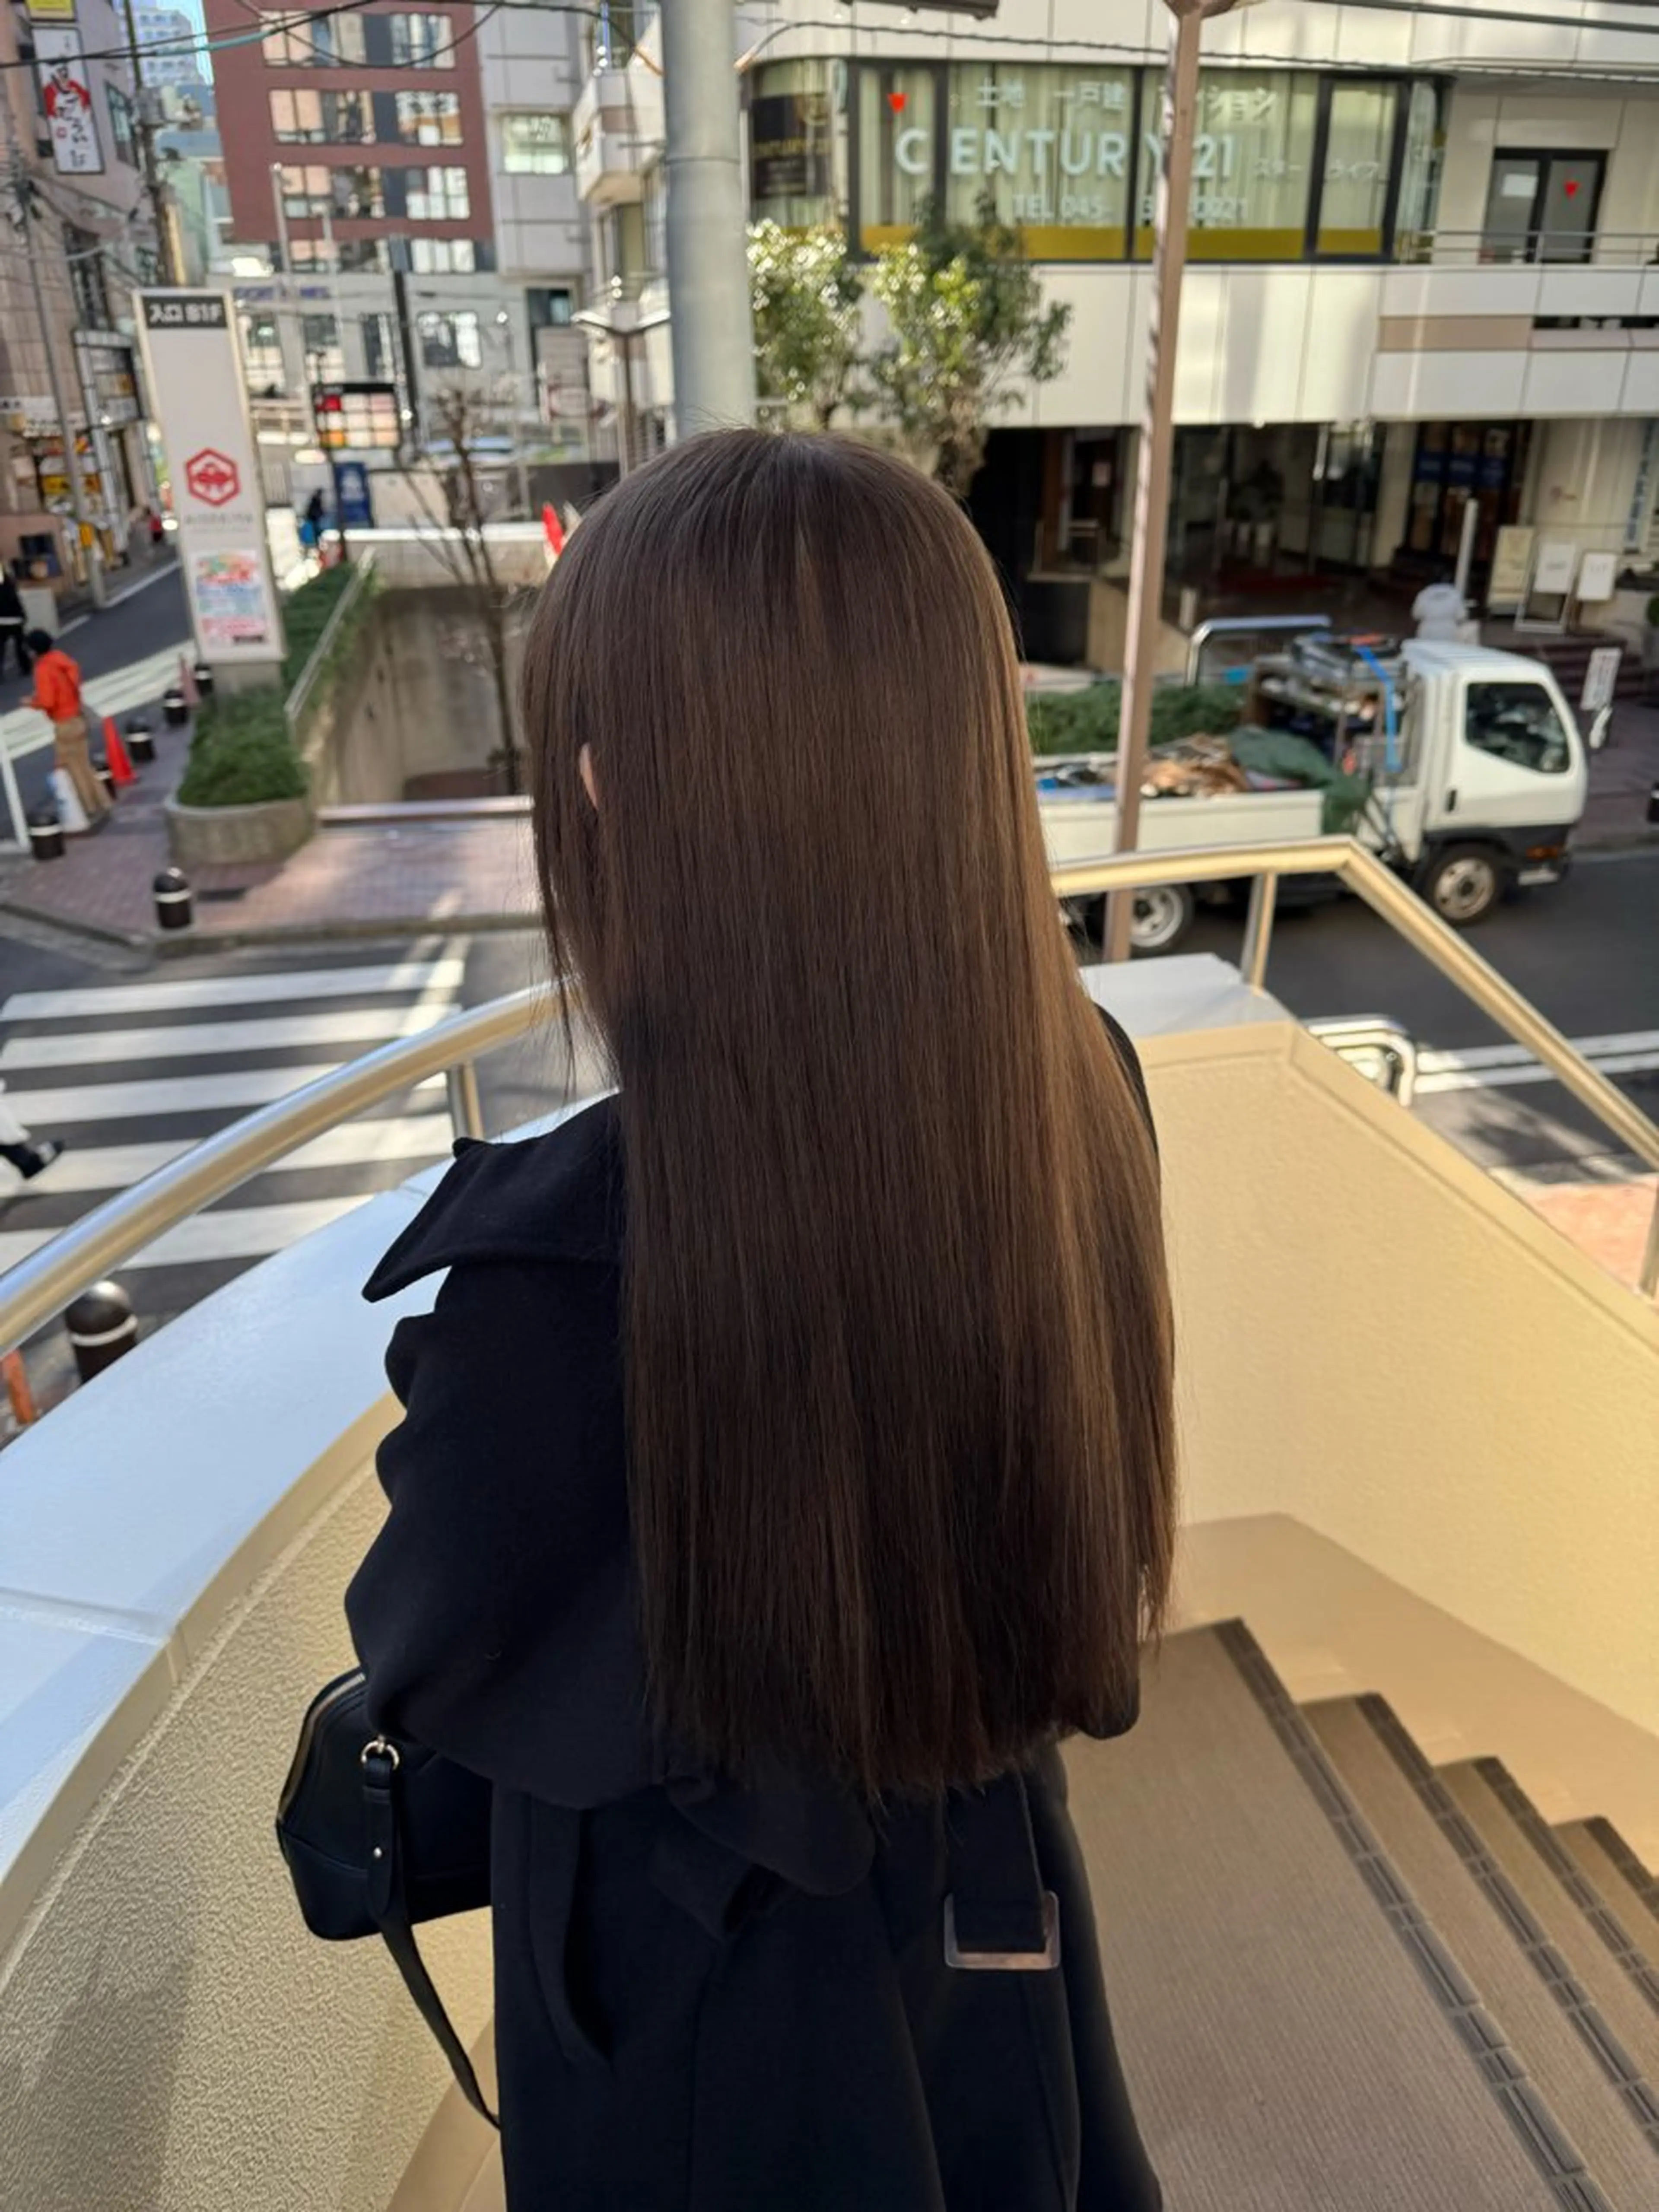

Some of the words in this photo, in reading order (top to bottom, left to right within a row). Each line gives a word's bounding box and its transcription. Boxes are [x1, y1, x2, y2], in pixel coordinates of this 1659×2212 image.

[976, 78, 1023, 108] 土地
[1193, 135, 1235, 177] 21
[1012, 194, 1054, 218] TEL
[149, 304, 184, 323] 入口
